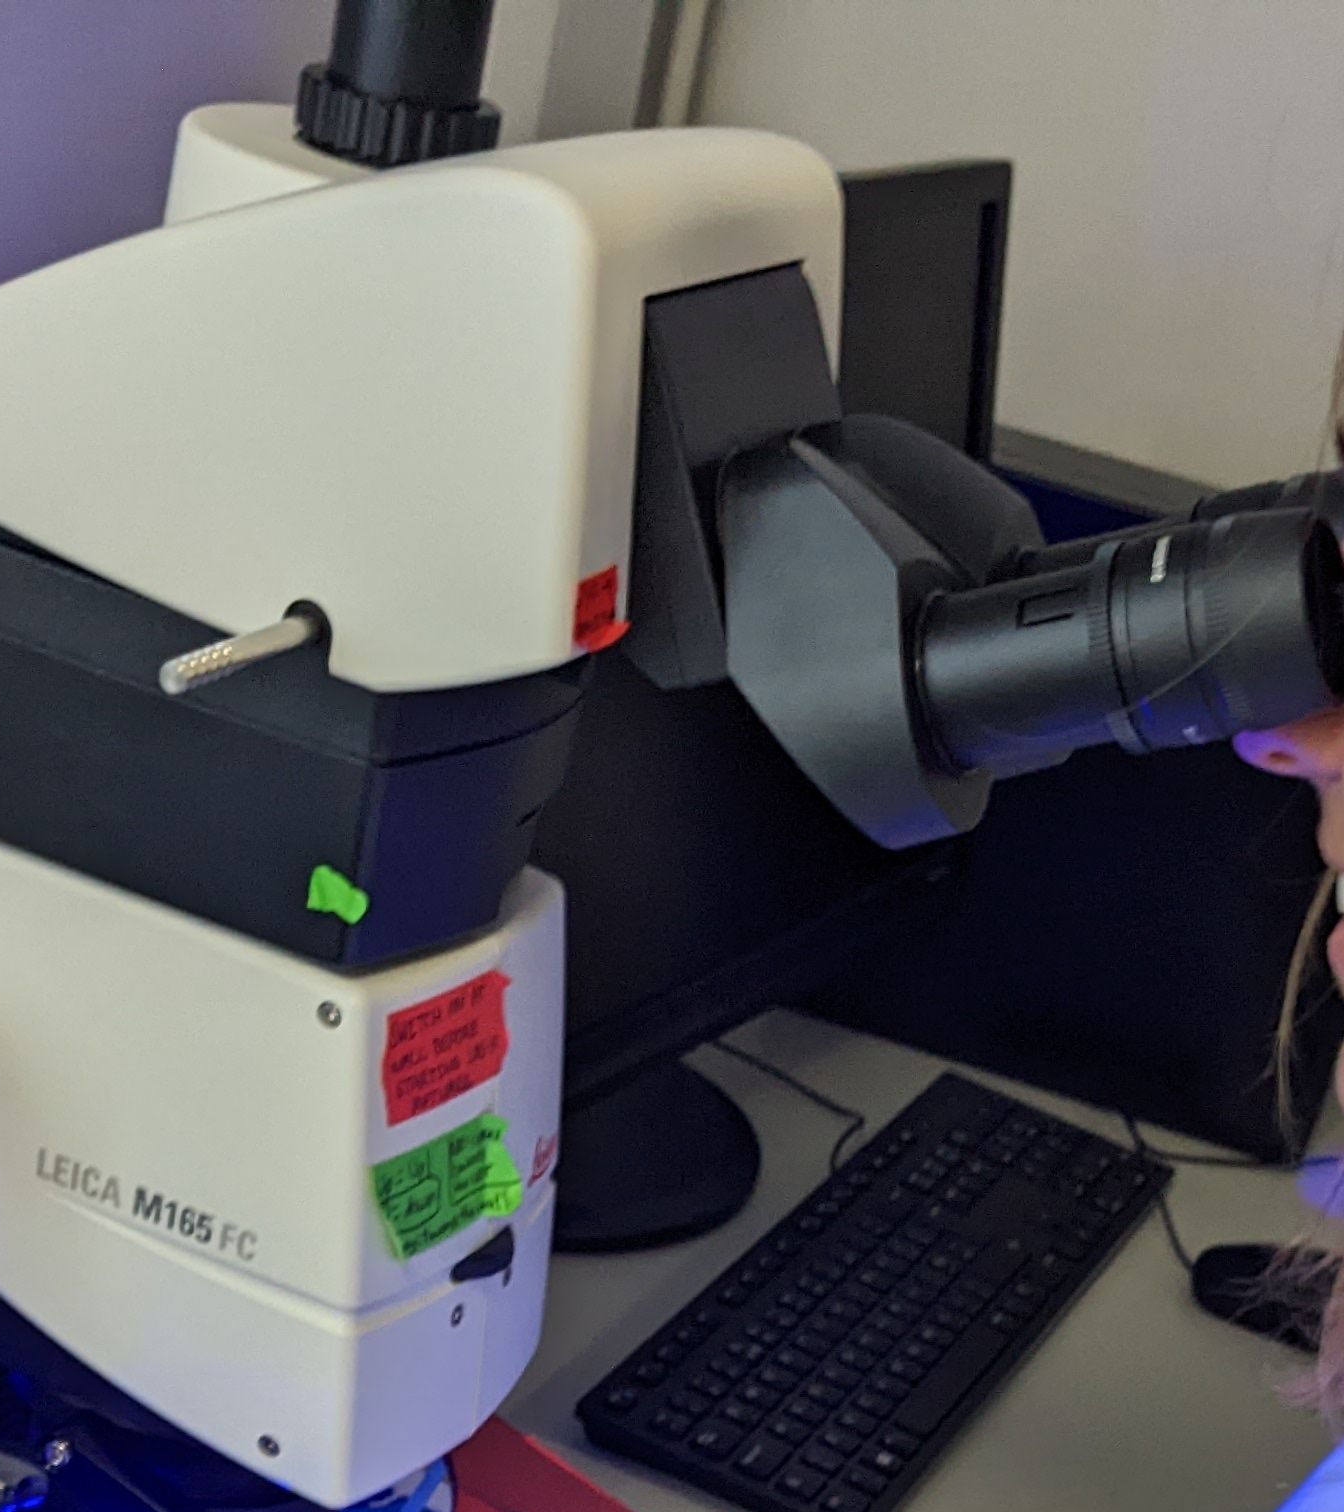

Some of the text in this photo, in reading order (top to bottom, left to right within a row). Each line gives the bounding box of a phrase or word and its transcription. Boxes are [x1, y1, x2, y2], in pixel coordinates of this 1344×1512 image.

[35, 1147, 257, 1261] LEICA M165 FC
